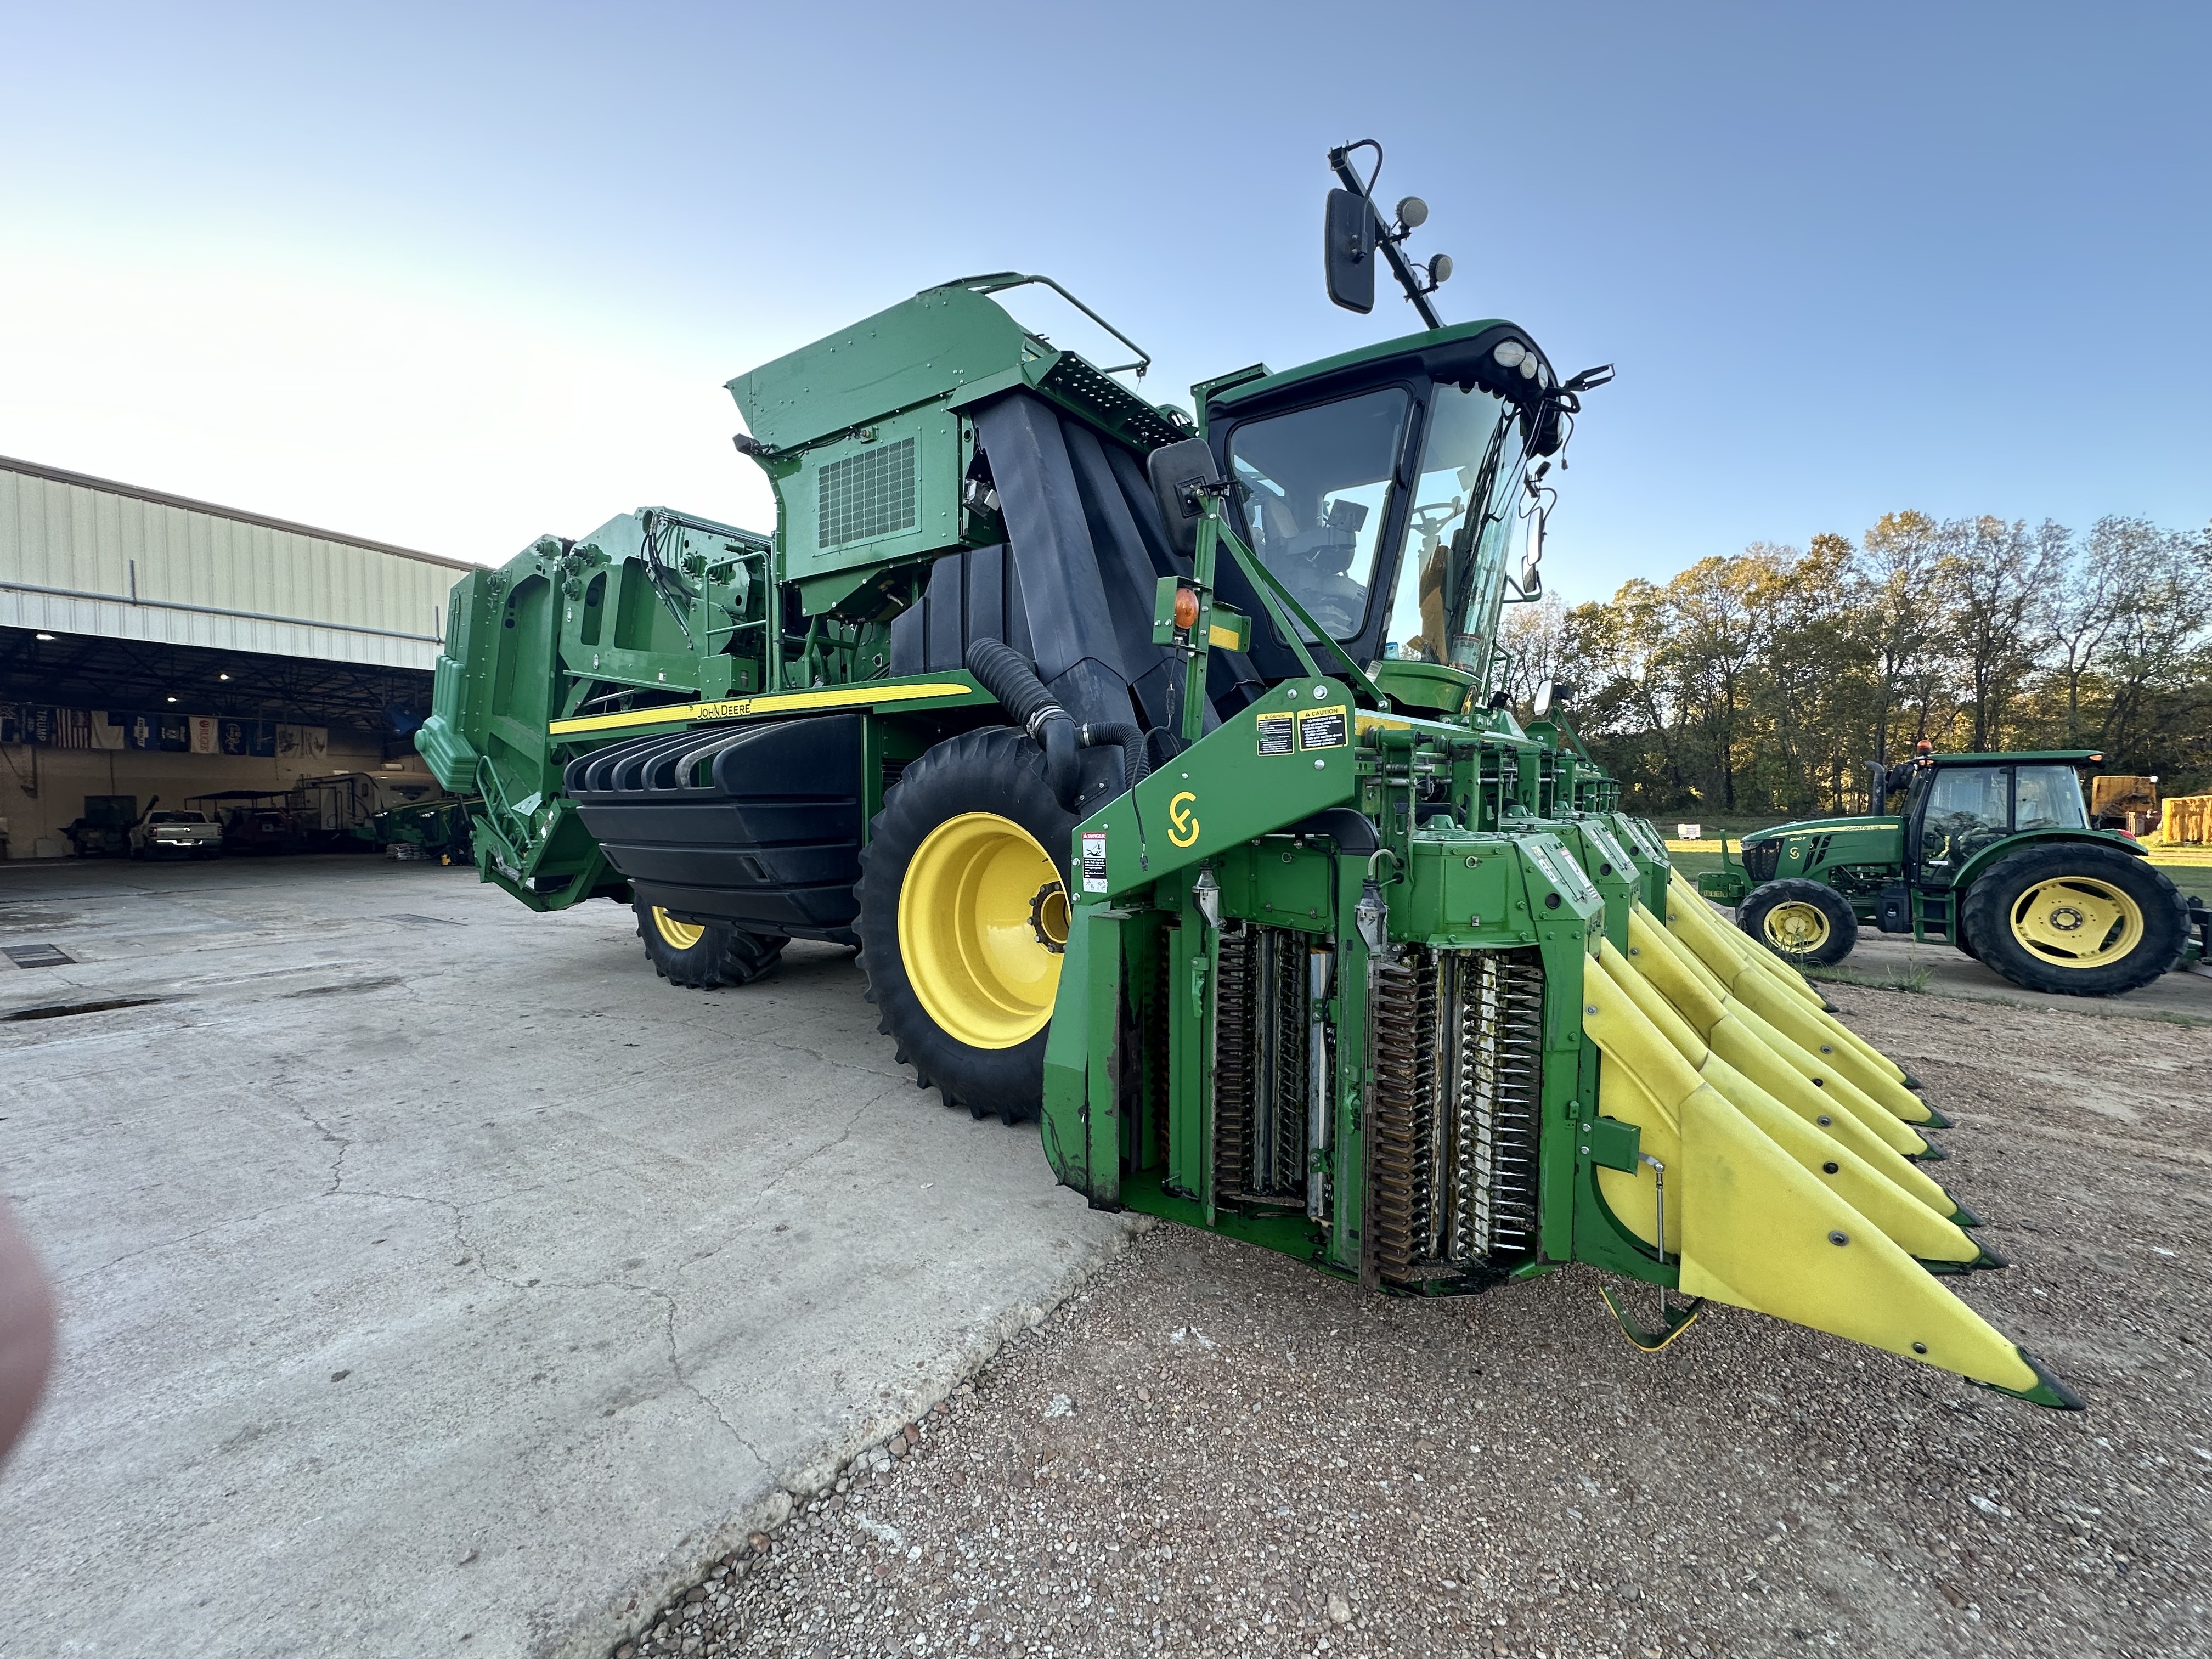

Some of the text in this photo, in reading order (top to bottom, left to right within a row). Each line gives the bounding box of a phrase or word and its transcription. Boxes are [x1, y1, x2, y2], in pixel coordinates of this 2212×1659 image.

[698, 704, 751, 718] JOHN DEERE
[1311, 708, 1338, 716] CAUTION
[36, 710, 47, 741] TRUMP
[199, 728, 209, 751] RUGER
